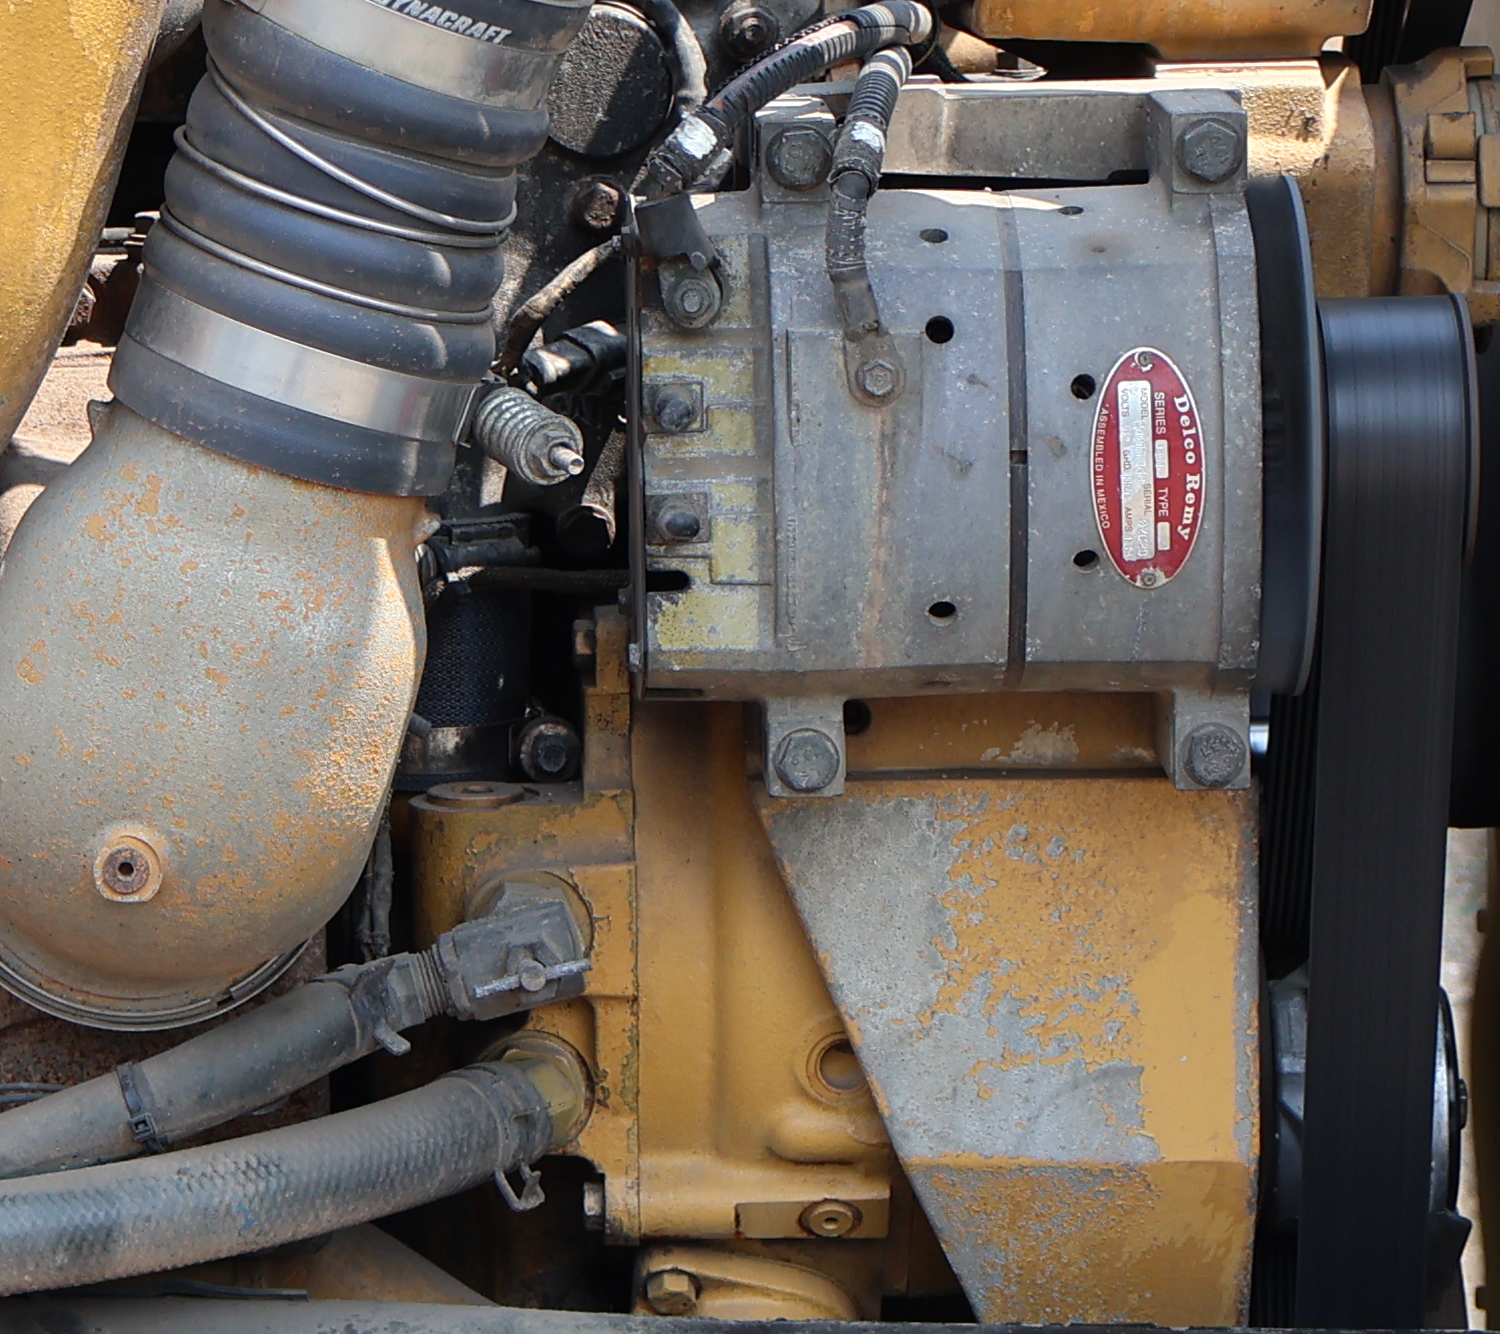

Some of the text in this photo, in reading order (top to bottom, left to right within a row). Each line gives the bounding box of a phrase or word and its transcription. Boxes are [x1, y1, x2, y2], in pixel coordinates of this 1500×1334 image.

[1121, 388, 1130, 418] VOLTS
[1155, 391, 1166, 435] SERIES
[1095, 407, 1110, 530] ASSEMBLED IN MEXICO
[1173, 393, 1201, 542] Delco Remy
[1143, 483, 1152, 516] SERIAL
[1158, 487, 1168, 517] TYPE
[1124, 506, 1132, 532] AMPS
